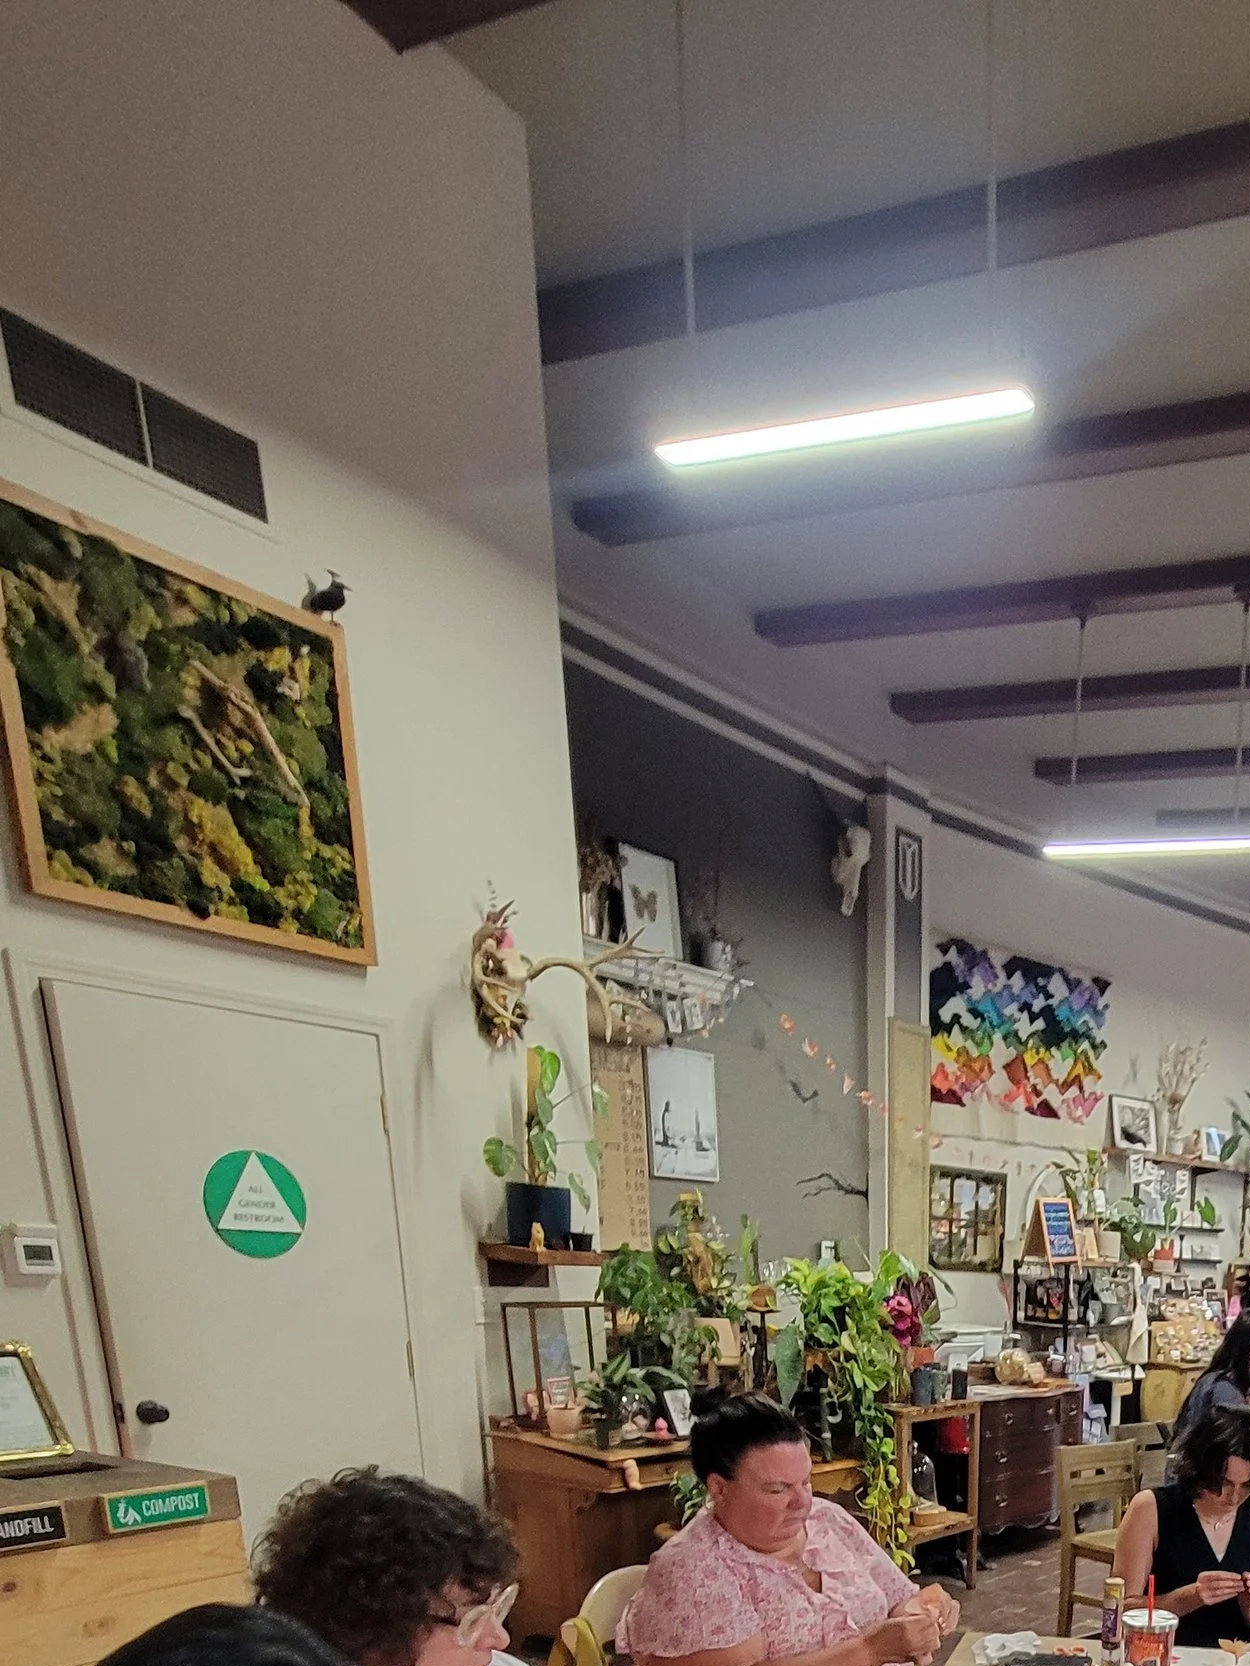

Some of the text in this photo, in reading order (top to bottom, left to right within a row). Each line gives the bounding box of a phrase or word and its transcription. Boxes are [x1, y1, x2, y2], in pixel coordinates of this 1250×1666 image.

[237, 1199, 276, 1209] GENDER
[233, 1212, 285, 1223] RESTROOM
[142, 1493, 200, 1517] COMPOST
